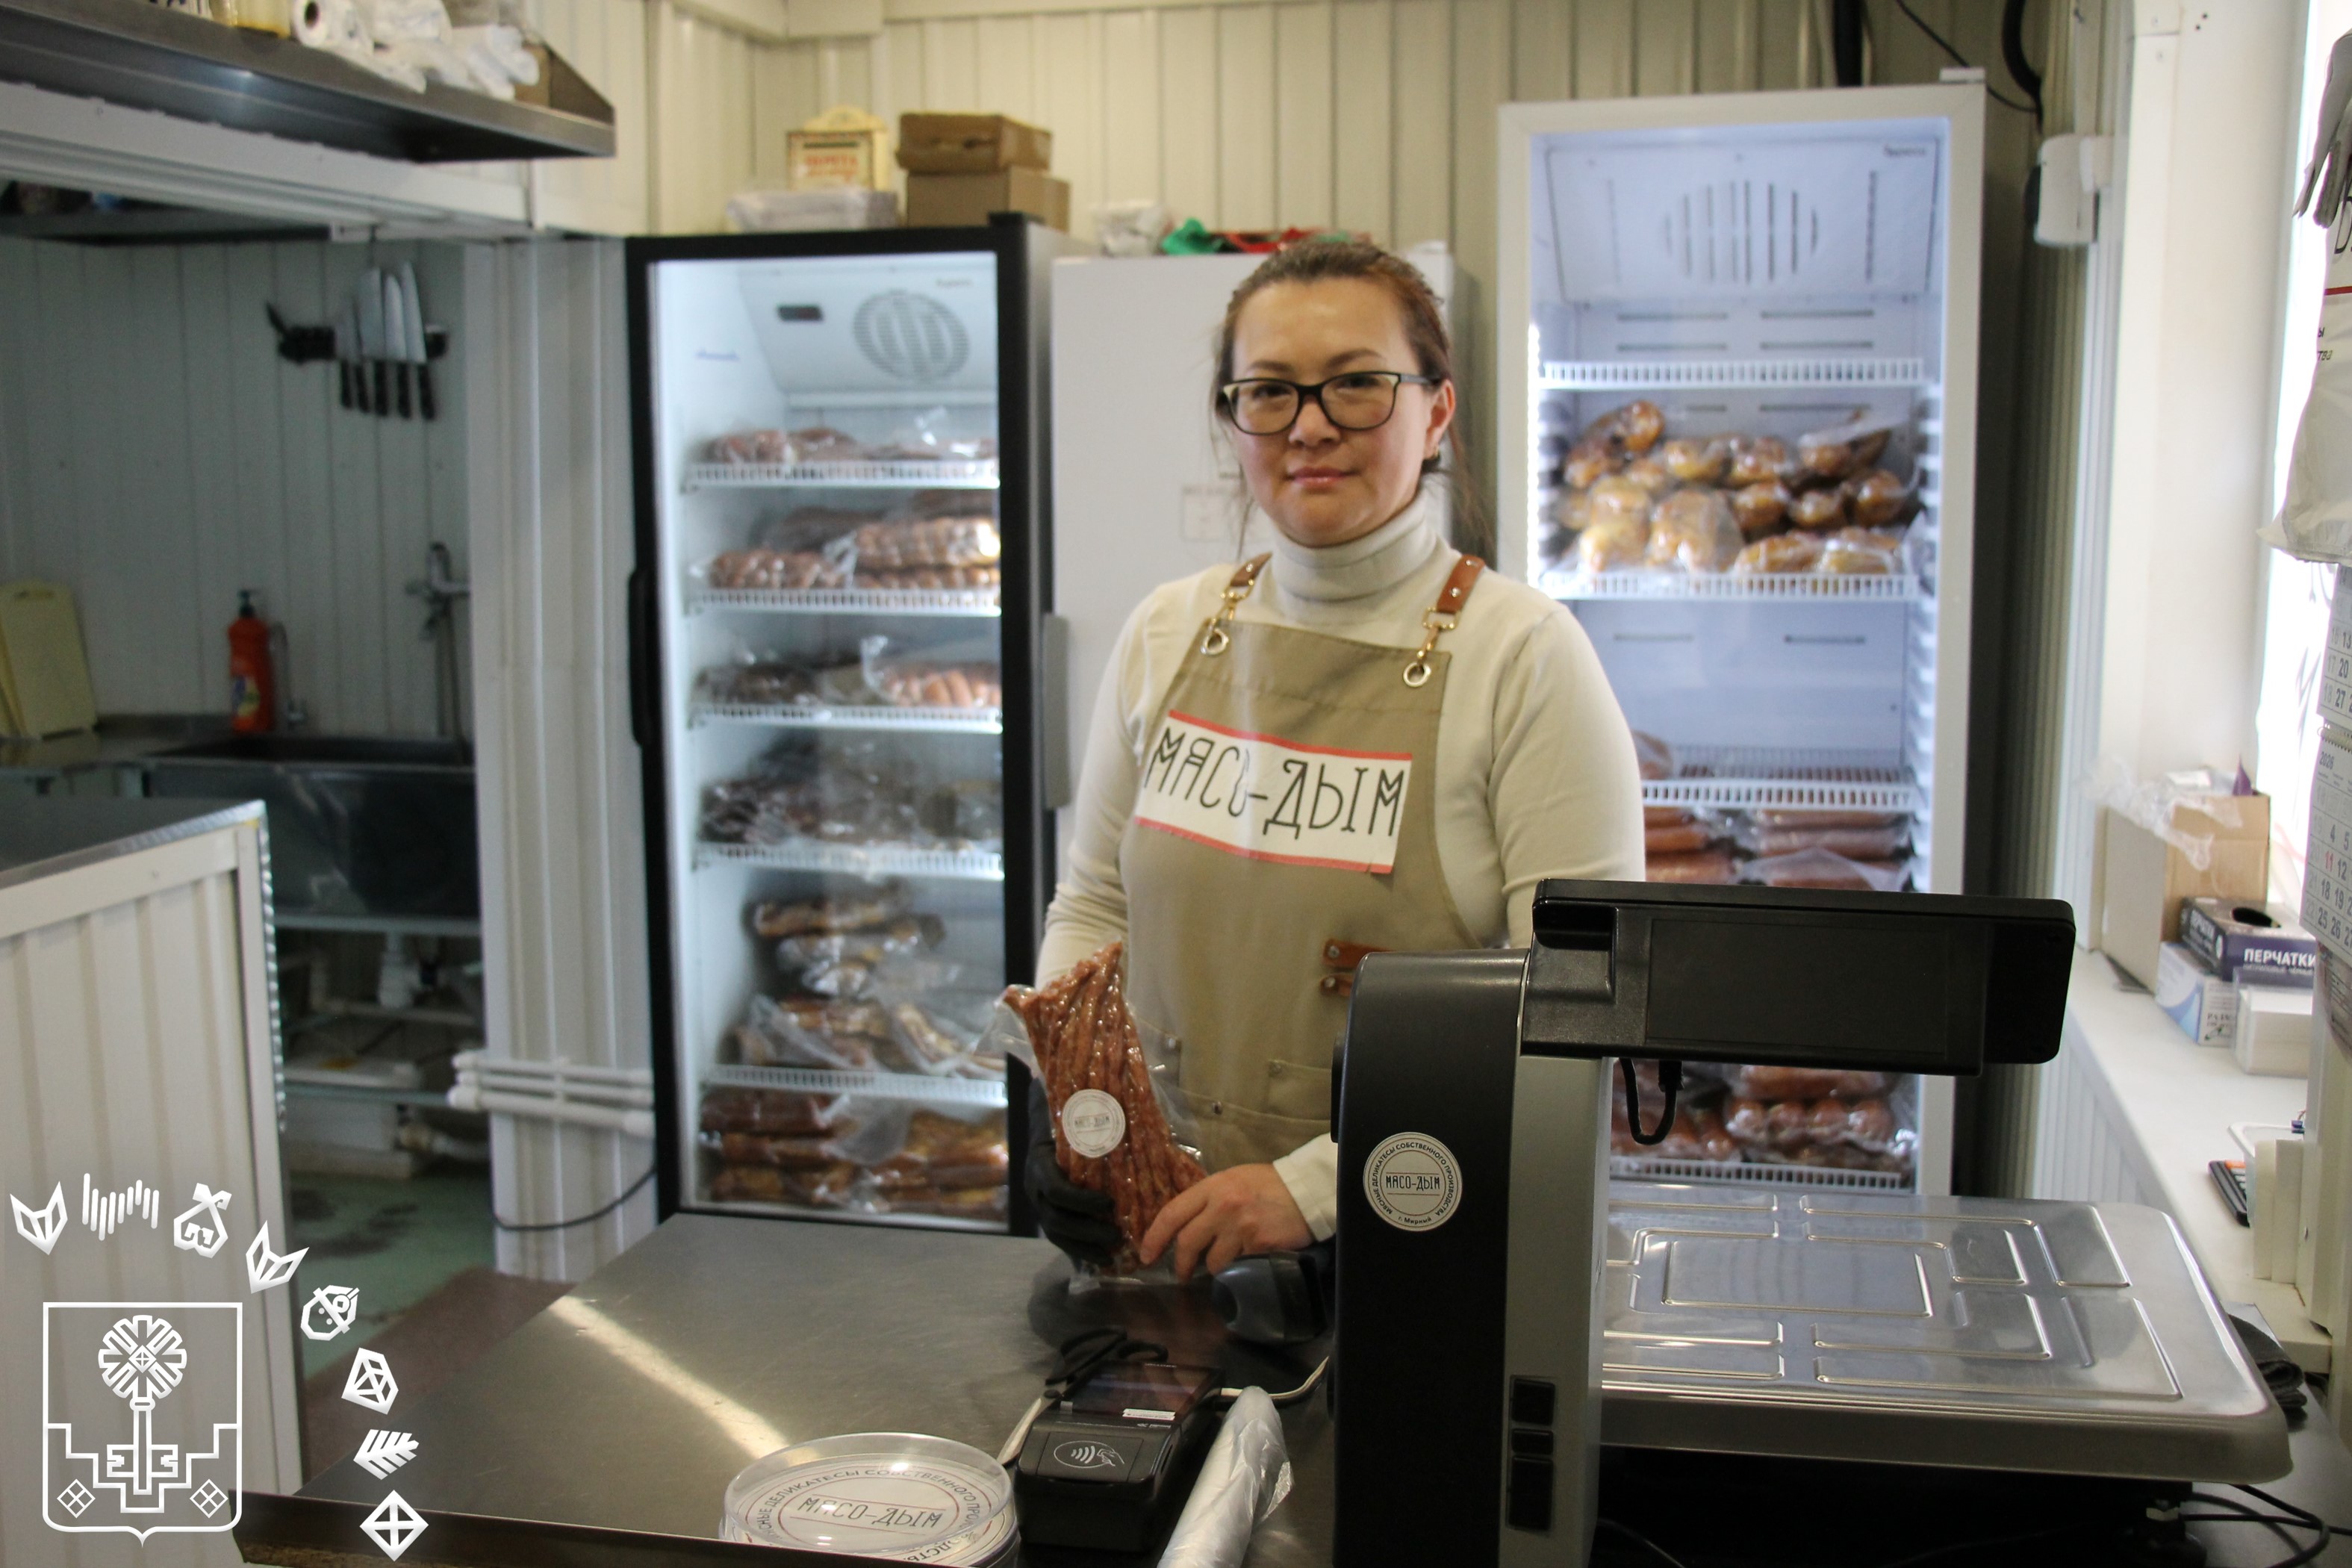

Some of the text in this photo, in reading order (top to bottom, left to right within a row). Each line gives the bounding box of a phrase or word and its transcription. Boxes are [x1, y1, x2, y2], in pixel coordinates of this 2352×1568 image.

[2342, 631, 2351, 649] 13
[2339, 657, 2349, 679] 20
[2335, 688, 2346, 709] 27
[1144, 727, 1405, 840] МЯСО-ДЫМ
[2330, 824, 2336, 843] 4
[2343, 831, 2350, 850] 5
[2325, 850, 2333, 872] 11
[2338, 858, 2347, 881] 12
[2321, 878, 2330, 900] 18
[2335, 888, 2344, 909] 19
[2318, 906, 2327, 930] 25
[2331, 916, 2341, 939] 26
[2244, 948, 2316, 968] ПЕРЧАТКИ
[1372, 1142, 1454, 1216] МЯСНЫЕ ДЕЛИКАТЕСЫ СОБСТВЕННОГО ПРОИЗВОДСТВА
[1385, 1175, 1440, 1192] МЯСО-ДЫМ
[1404, 1216, 1432, 1225] Мирный
[765, 1469, 859, 1507] ДЕЛИКАТЕСЫ
[865, 1469, 977, 1502] СОБСТВЕННОГО
[797, 1497, 943, 1528] МЯСО-ДЫМ
